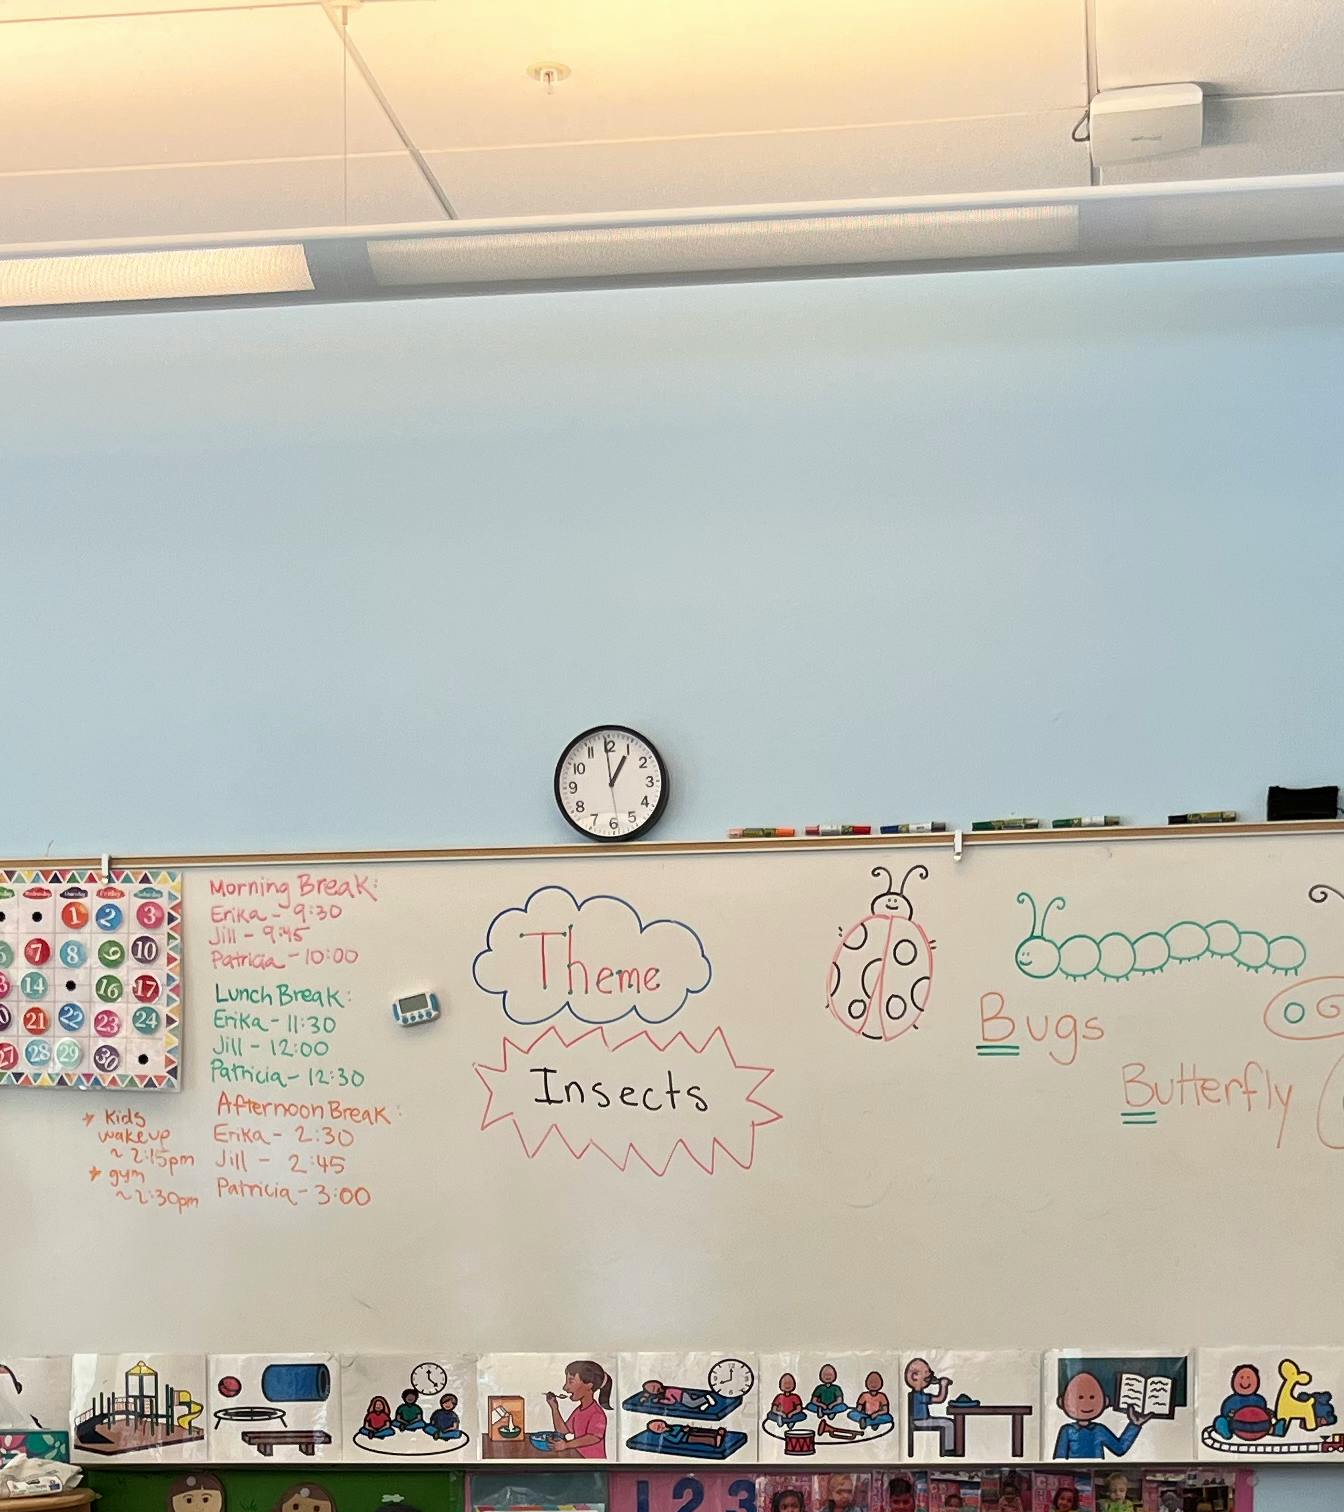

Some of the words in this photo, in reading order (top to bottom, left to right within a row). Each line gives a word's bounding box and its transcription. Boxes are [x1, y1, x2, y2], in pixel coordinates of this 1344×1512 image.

[588, 746, 594, 759] 11
[627, 743, 630, 755] 1
[574, 763, 585, 774] 10
[639, 757, 647, 768] 2
[569, 782, 577, 794] 9
[646, 776, 654, 787] 3
[576, 801, 584, 812] 8
[641, 796, 649, 807] 4
[590, 814, 598, 826] 7
[609, 818, 618, 829] 6
[628, 811, 636, 823] 5
[210, 879, 291, 909] Morning
[71, 907, 80, 923] 1
[100, 908, 115, 927] 2
[143, 907, 156, 923] 3
[211, 906, 267, 923] Erika
[294, 904, 342, 922] 9:30
[209, 927, 236, 945] Jill
[263, 926, 310, 943] 9:45
[33, 945, 42, 961] 7
[68, 946, 77, 962] 8
[135, 942, 157, 958] 10
[210, 950, 286, 970] Patricia
[305, 948, 359, 964] 10:00
[519, 924, 661, 995] Theme
[25, 978, 44, 994] 14
[99, 981, 119, 998] 16
[135, 981, 156, 997] 17
[215, 984, 272, 1005] Lunch
[26, 1015, 46, 1030] 21
[61, 1008, 83, 1028] 22
[97, 1017, 119, 1032] 23
[135, 1013, 157, 1028] 24
[213, 1009, 269, 1031] Erika
[288, 1015, 336, 1034] 11:30
[980, 991, 1105, 1065] Bugs
[213, 1036, 242, 1056] Jill
[271, 1039, 329, 1057] 12:00
[29, 1045, 50, 1060] 28
[60, 1045, 79, 1061] 29
[96, 1049, 117, 1069] 30
[309, 1068, 365, 1086] 12:30
[530, 1067, 709, 1111] Insects
[217, 1091, 324, 1122] Afternoon
[1122, 1061, 1293, 1148] Butterfly
[105, 1109, 146, 1128] Kids
[214, 1125, 270, 1145] Erika
[296, 1125, 354, 1146] 2:30
[215, 1151, 247, 1172] Jill
[289, 1154, 347, 1174] 2:45
[110, 1168, 145, 1186] gym
[217, 1177, 297, 1205] Patricia
[315, 1184, 371, 1206] 3:00
